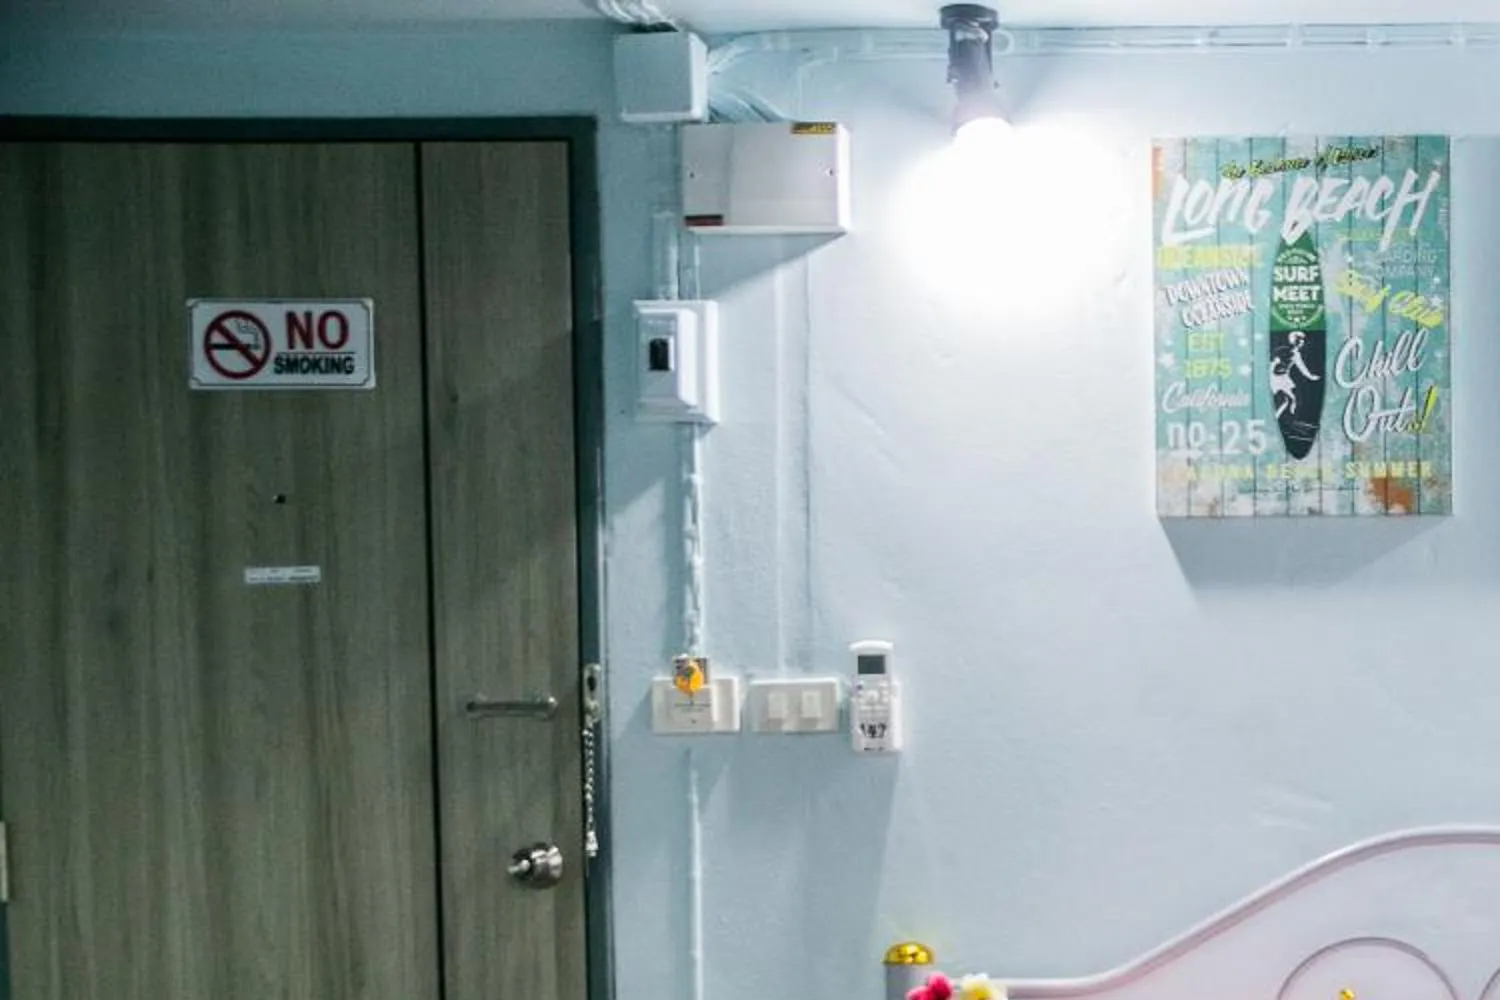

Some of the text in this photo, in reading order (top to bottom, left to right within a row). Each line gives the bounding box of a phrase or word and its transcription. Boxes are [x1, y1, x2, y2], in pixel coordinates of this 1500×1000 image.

[1161, 161, 1441, 252] LONG BEACH
[1273, 265, 1319, 282] SURF
[1273, 286, 1321, 301] MEET
[286, 310, 349, 350] NO
[274, 356, 355, 376] SMOKING
[1335, 329, 1429, 389] Chill
